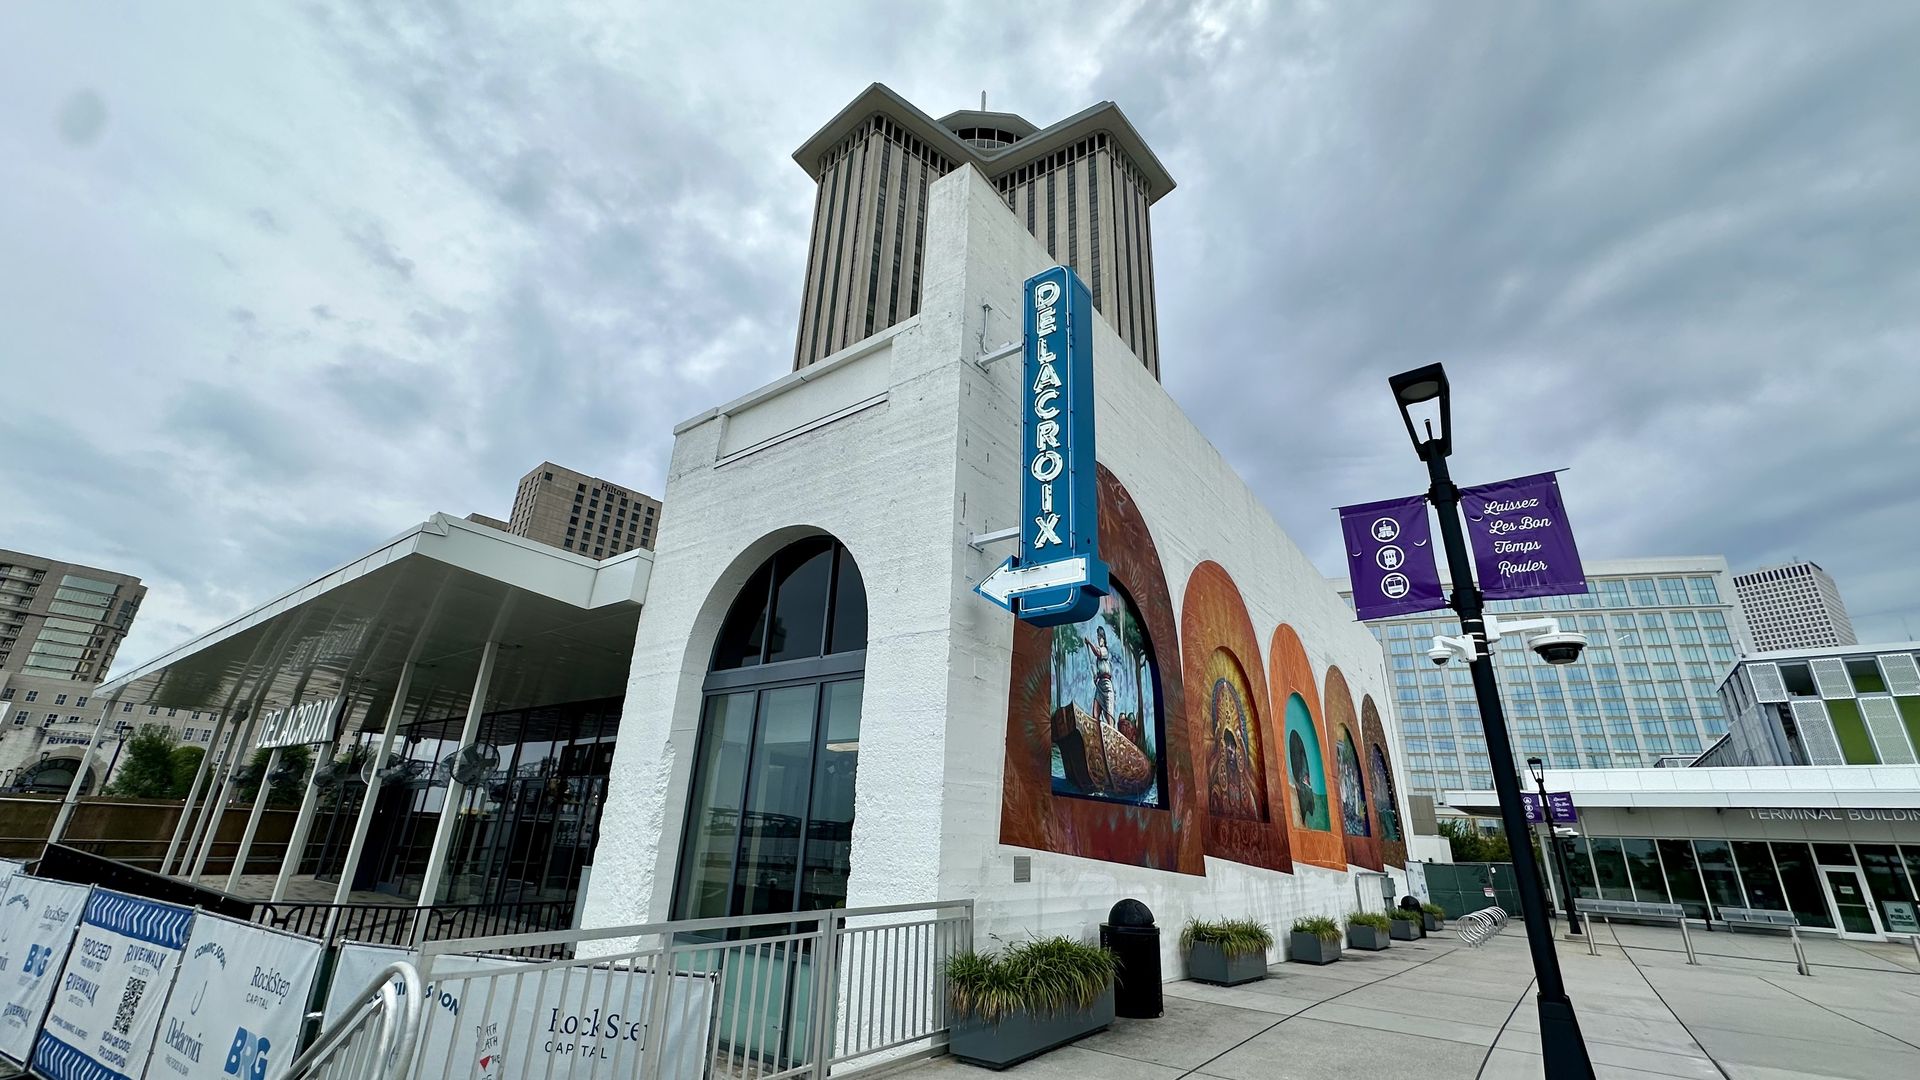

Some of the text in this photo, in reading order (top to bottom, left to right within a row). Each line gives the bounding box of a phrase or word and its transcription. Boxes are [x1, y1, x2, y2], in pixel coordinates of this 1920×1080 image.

[1031, 281, 1063, 549] DELACROIX
[601, 482, 627, 498] Hilton
[1483, 498, 1540, 515] Laissez
[1489, 516, 1552, 535] Les Bon
[1494, 538, 1542, 554] Temps
[1498, 560, 1548, 578] Rouler
[255, 697, 338, 748] DELACROIX
[47, 736, 105, 749] RIVERWAK
[1747, 808, 1843, 820] TERMINAL
[81, 937, 112, 961] PROCEED
[194, 942, 216, 959] COMING
[23, 944, 52, 977] BRG
[123, 944, 167, 976] RIVERWALK
[65, 972, 100, 1008] RIVERWALK
[250, 966, 290, 1005] RockStep
[246, 993, 268, 1010] CAPITAL
[425, 985, 459, 1016] SON
[165, 1017, 203, 1063] Delacroix
[544, 1041, 607, 1059] CAPTAL
[224, 1026, 271, 1080] BRG
